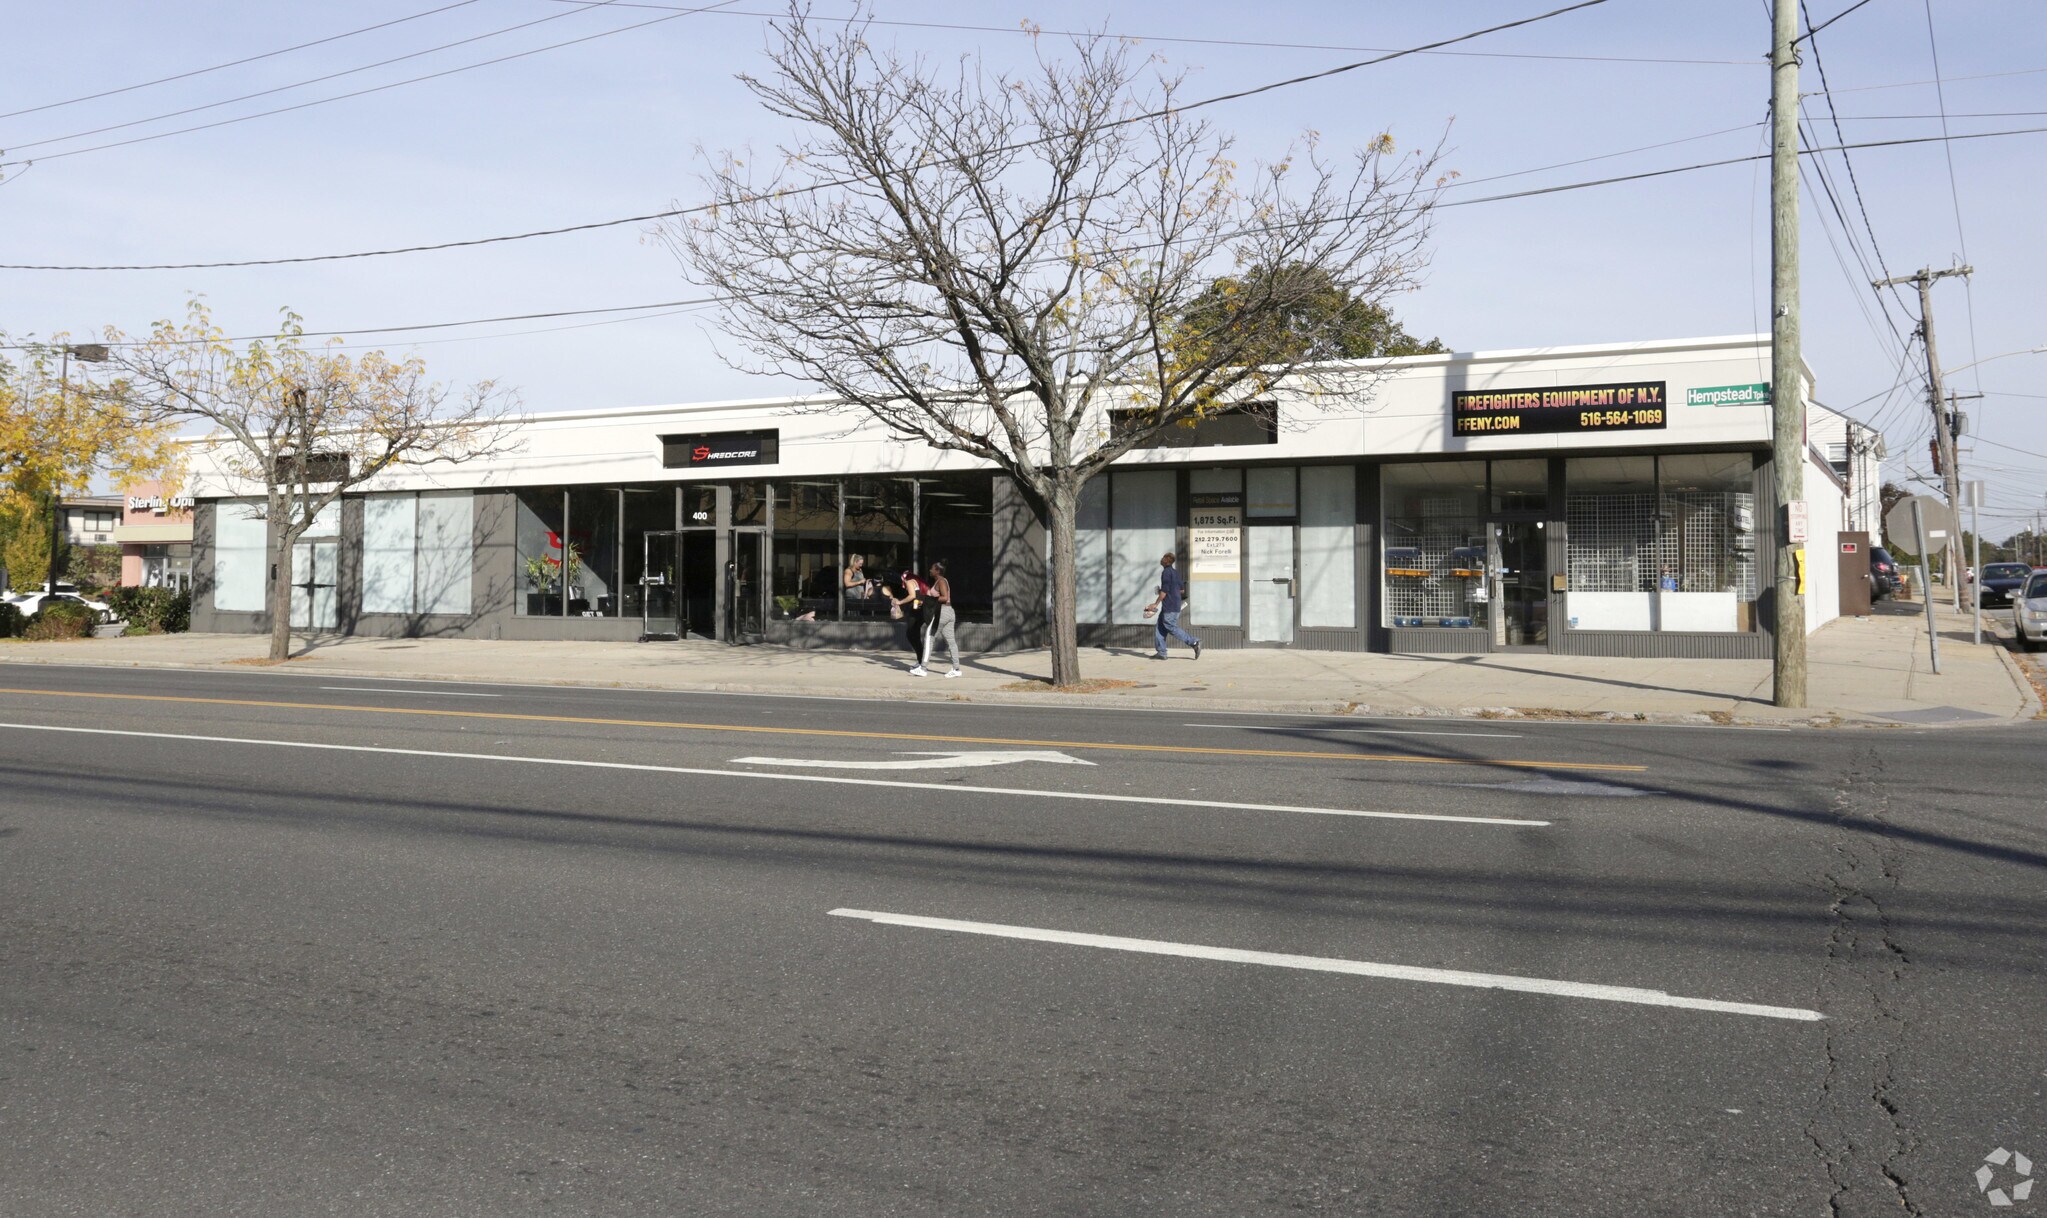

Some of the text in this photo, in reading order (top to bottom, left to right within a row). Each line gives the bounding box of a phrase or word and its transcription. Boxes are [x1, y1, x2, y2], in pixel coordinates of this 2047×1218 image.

[1457, 387, 1662, 411] FIREFIGHTERS EQUIPMENT OF N.Y.
[1688, 385, 1752, 404] Hempstead
[1457, 409, 1663, 431] FFENY.COM 516-564-1069
[692, 511, 708, 520] 400
[1194, 516, 1214, 525] 1,875
